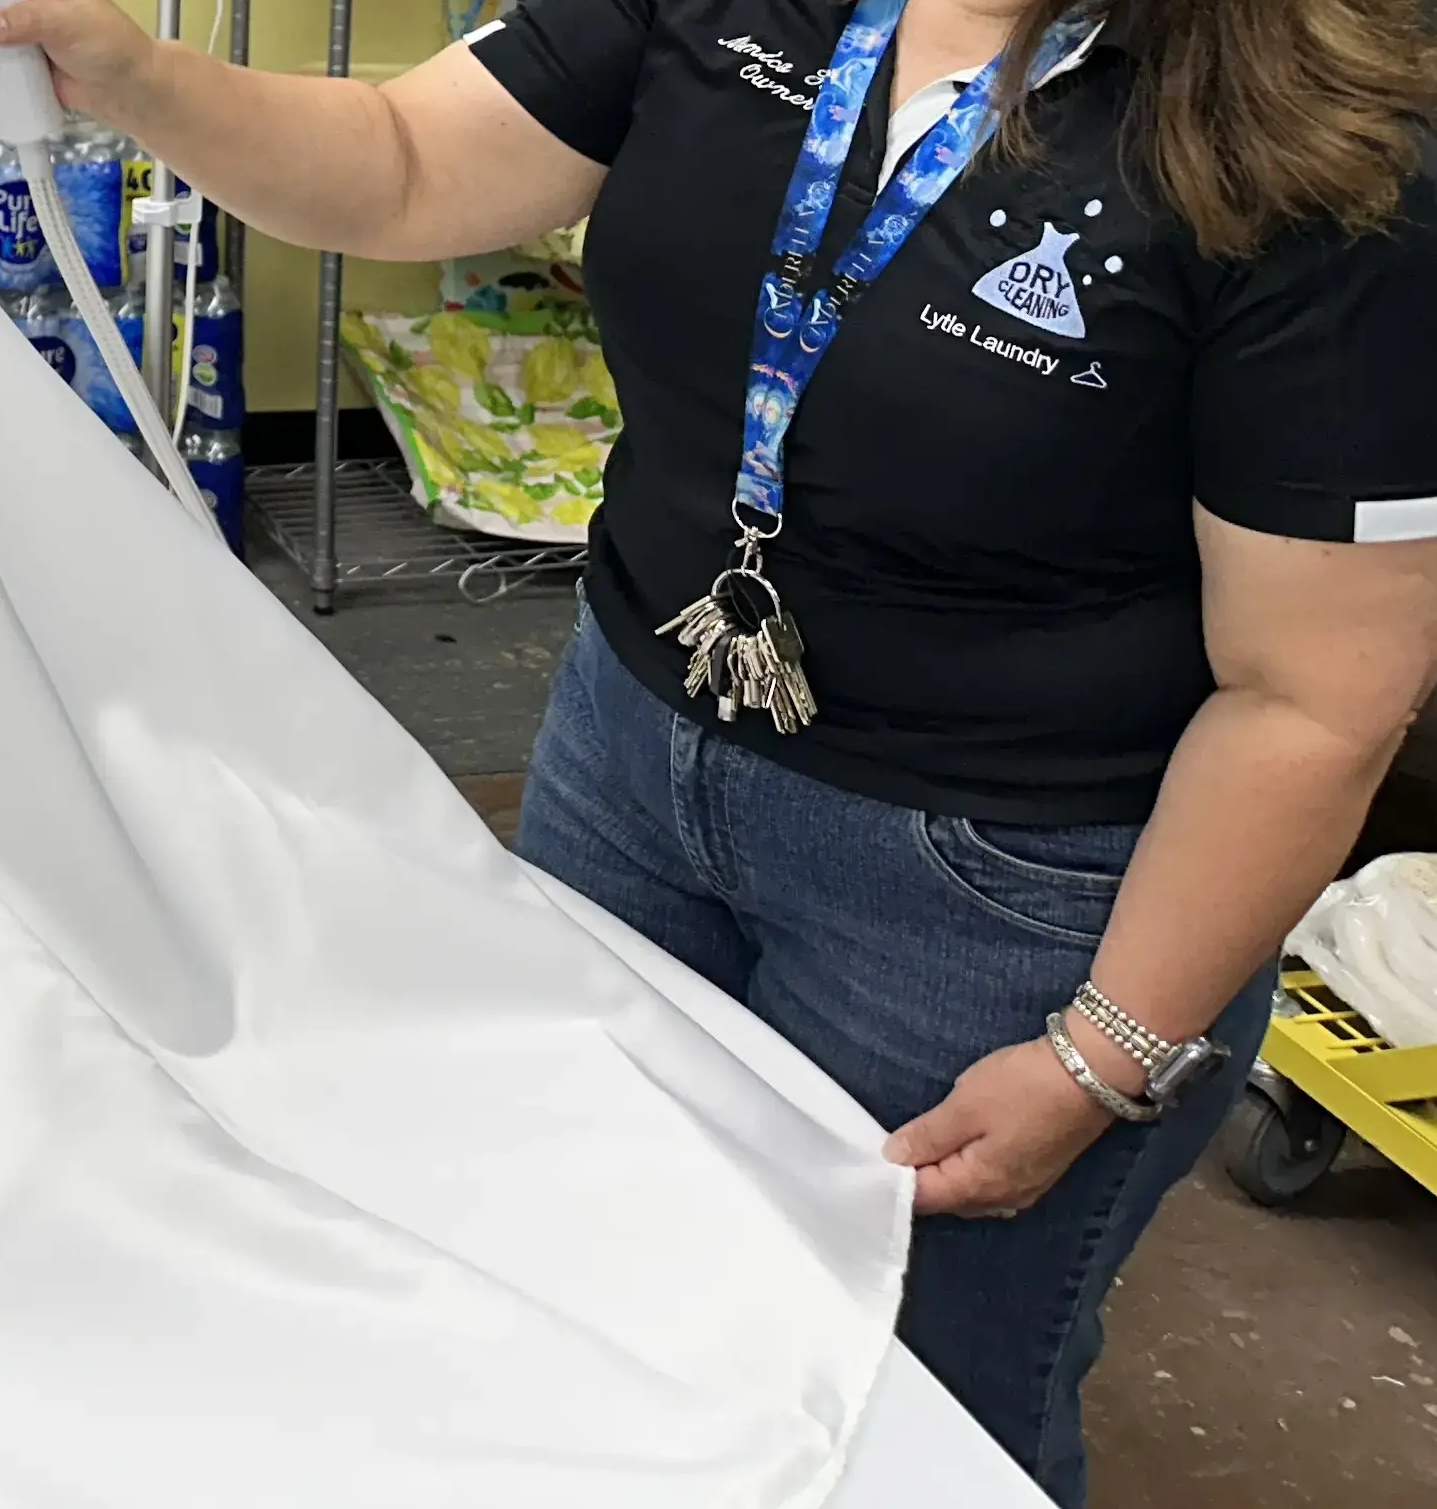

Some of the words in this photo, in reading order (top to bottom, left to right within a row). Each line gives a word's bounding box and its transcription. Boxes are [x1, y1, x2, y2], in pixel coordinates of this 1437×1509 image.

[739, 64, 815, 110] Owner
[998, 280, 1070, 320] CLEANING
[1008, 261, 1070, 299] DRY
[920, 303, 966, 337] Lytle
[970, 325, 1060, 375] Laundry
